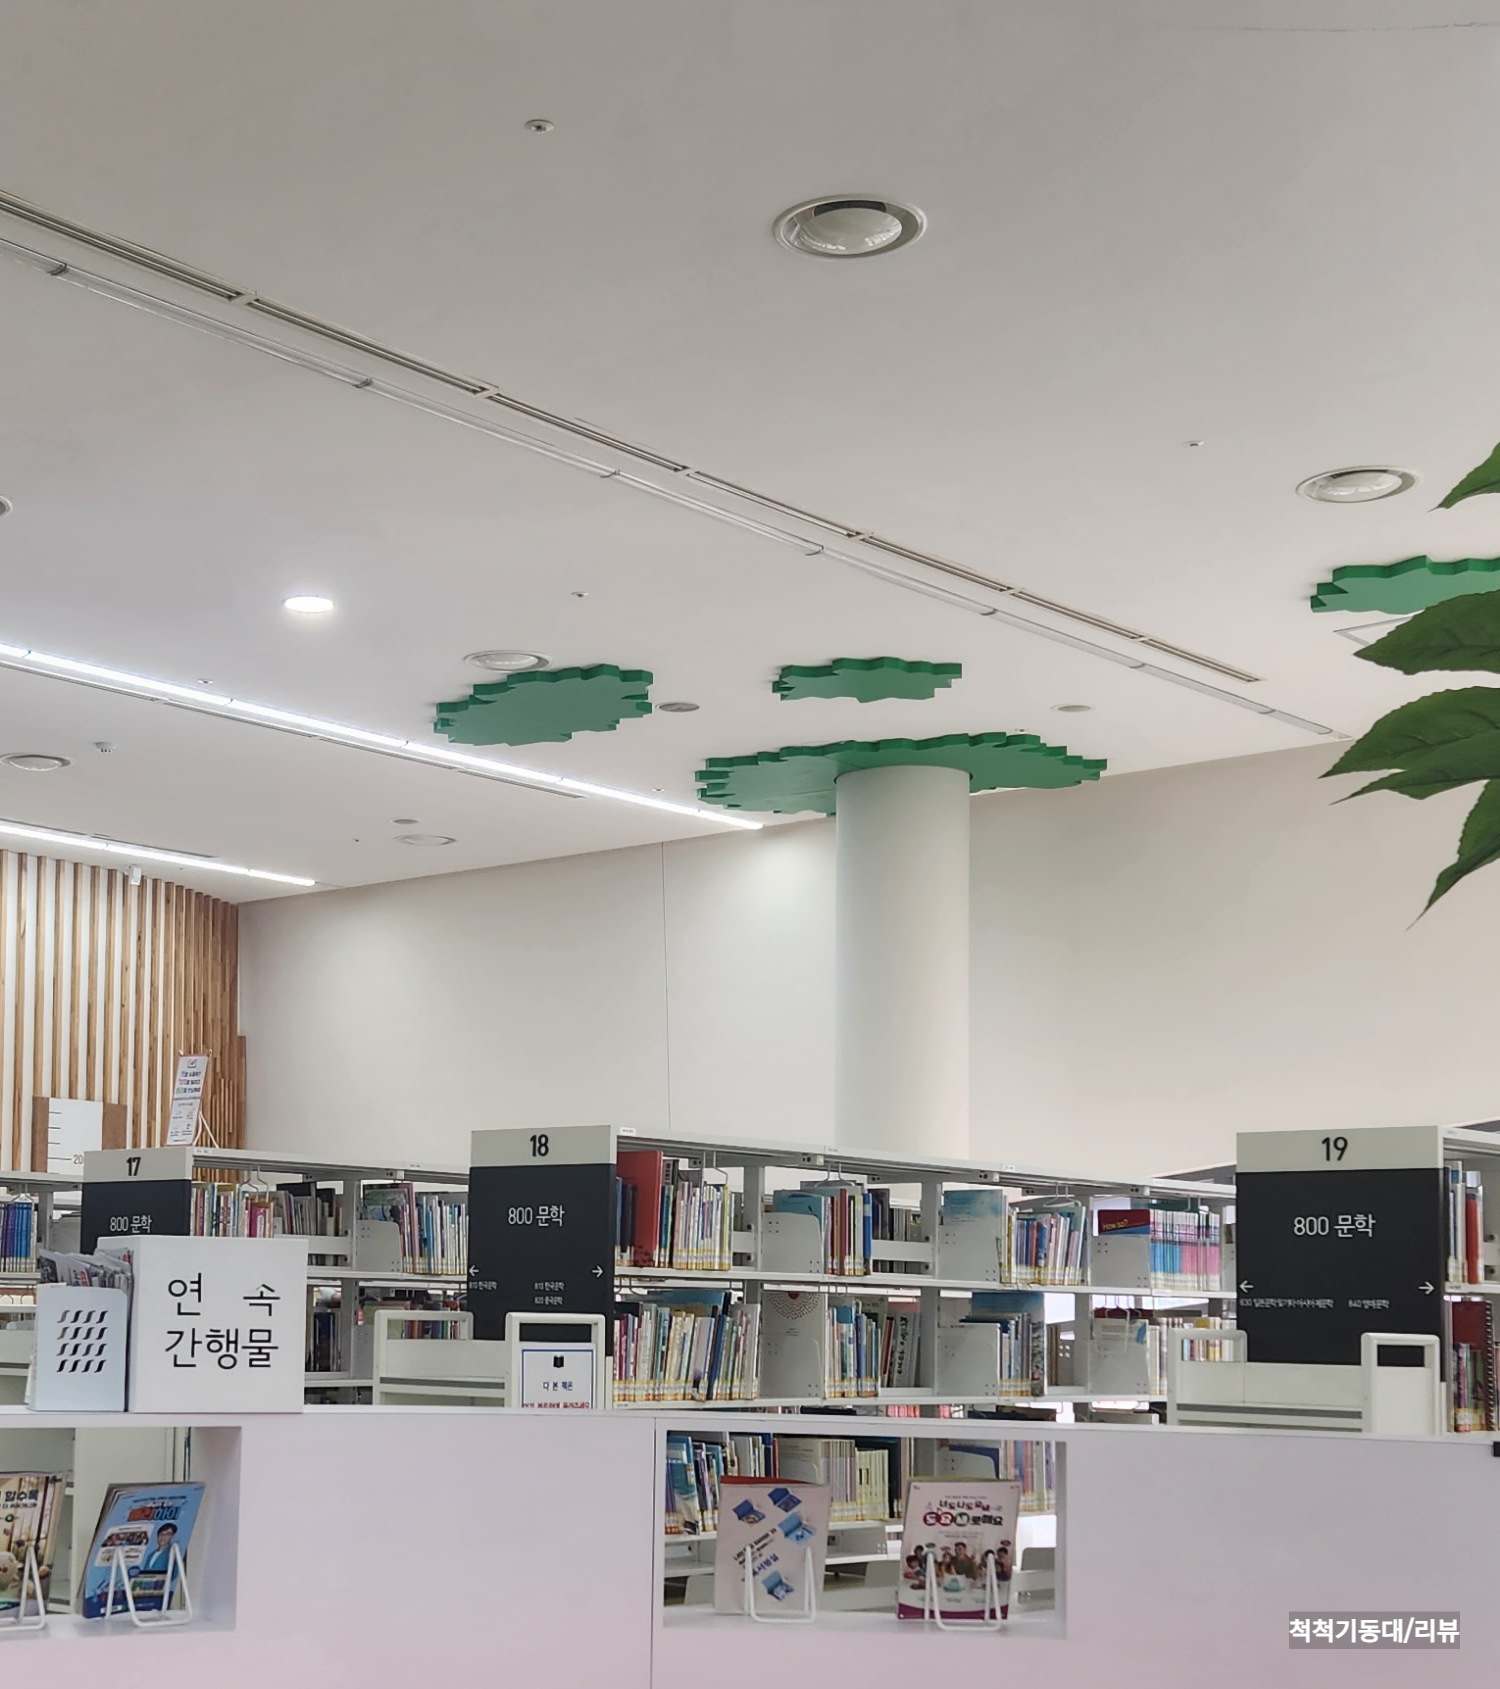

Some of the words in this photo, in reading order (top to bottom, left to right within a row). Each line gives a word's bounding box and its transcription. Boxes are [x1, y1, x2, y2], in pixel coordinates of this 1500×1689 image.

[529, 1133, 549, 1157] 18
[1321, 1136, 1348, 1161] 19
[126, 1156, 141, 1177] 17
[109, 1216, 129, 1231] 800
[130, 1214, 152, 1233] 문학
[508, 1207, 533, 1225] 800
[536, 1205, 565, 1227] 문학
[1293, 1216, 1329, 1236] 800
[1333, 1213, 1376, 1237] 문학
[165, 1327, 279, 1370] 간행물
